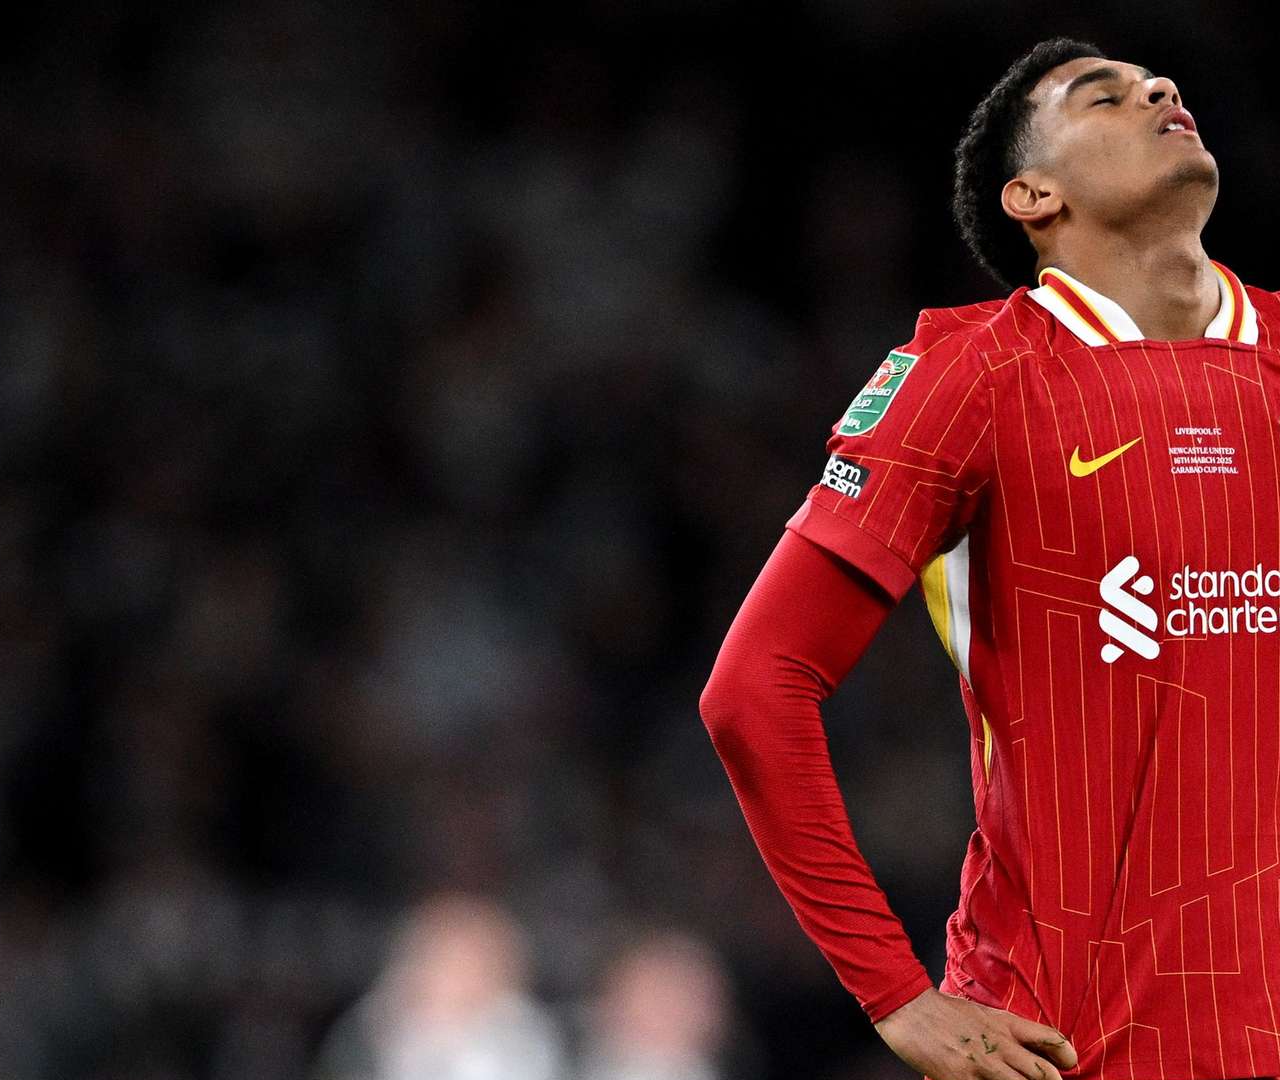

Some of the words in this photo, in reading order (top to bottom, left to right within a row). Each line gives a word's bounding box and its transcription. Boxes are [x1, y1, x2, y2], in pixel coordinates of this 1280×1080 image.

[1175, 427, 1213, 435] LIVERPOOL
[1213, 427, 1222, 435] FC
[1168, 447, 1208, 455] NEWCASTLE
[1209, 447, 1235, 455] UNITED
[1173, 457, 1190, 465] 16TH
[1171, 466, 1203, 474] CARABAO
